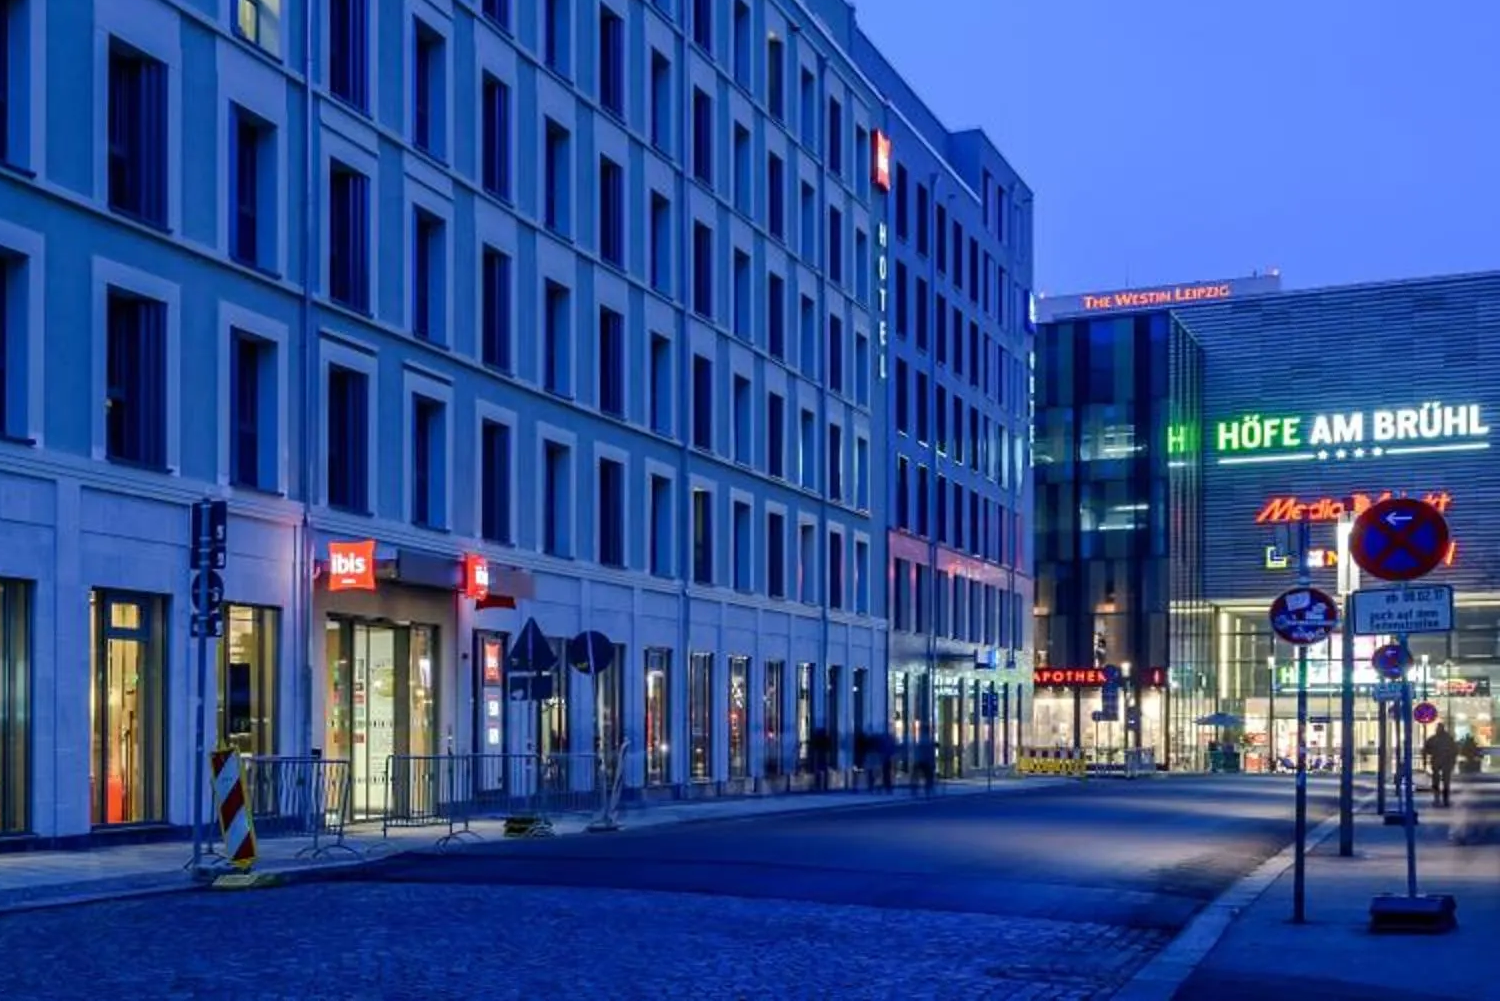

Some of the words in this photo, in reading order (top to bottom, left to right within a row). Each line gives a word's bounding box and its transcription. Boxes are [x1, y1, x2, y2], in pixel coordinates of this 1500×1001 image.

[878, 221, 888, 379] HOTEL
[1217, 414, 1301, 451] HÖFE
[1308, 412, 1364, 445] AM
[1373, 400, 1490, 440] BRÜHL
[331, 552, 366, 575] ibis
[1032, 670, 1107, 682] APOTHEK
